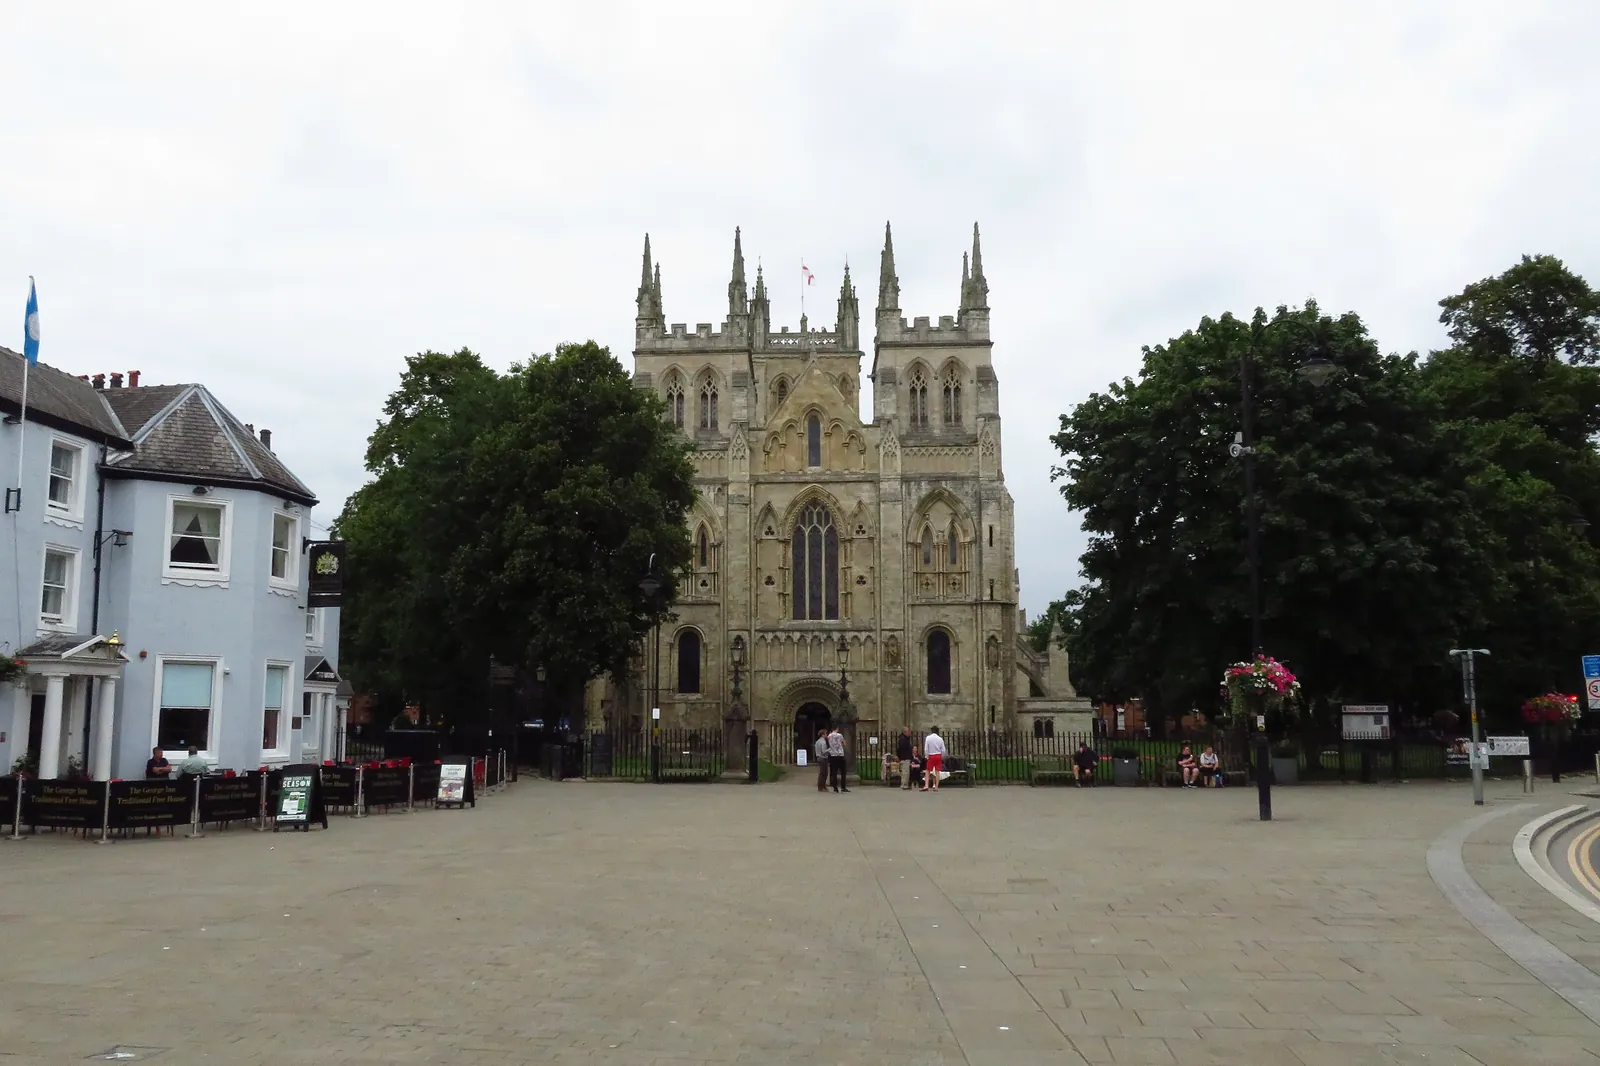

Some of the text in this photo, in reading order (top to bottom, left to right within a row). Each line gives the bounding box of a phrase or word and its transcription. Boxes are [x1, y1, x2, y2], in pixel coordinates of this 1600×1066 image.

[282, 780, 311, 788] SEASON
[44, 786, 88, 795] The George Inn
[130, 787, 141, 795] The
[142, 787, 164, 795] George
[31, 794, 98, 805] Traditional Free House
